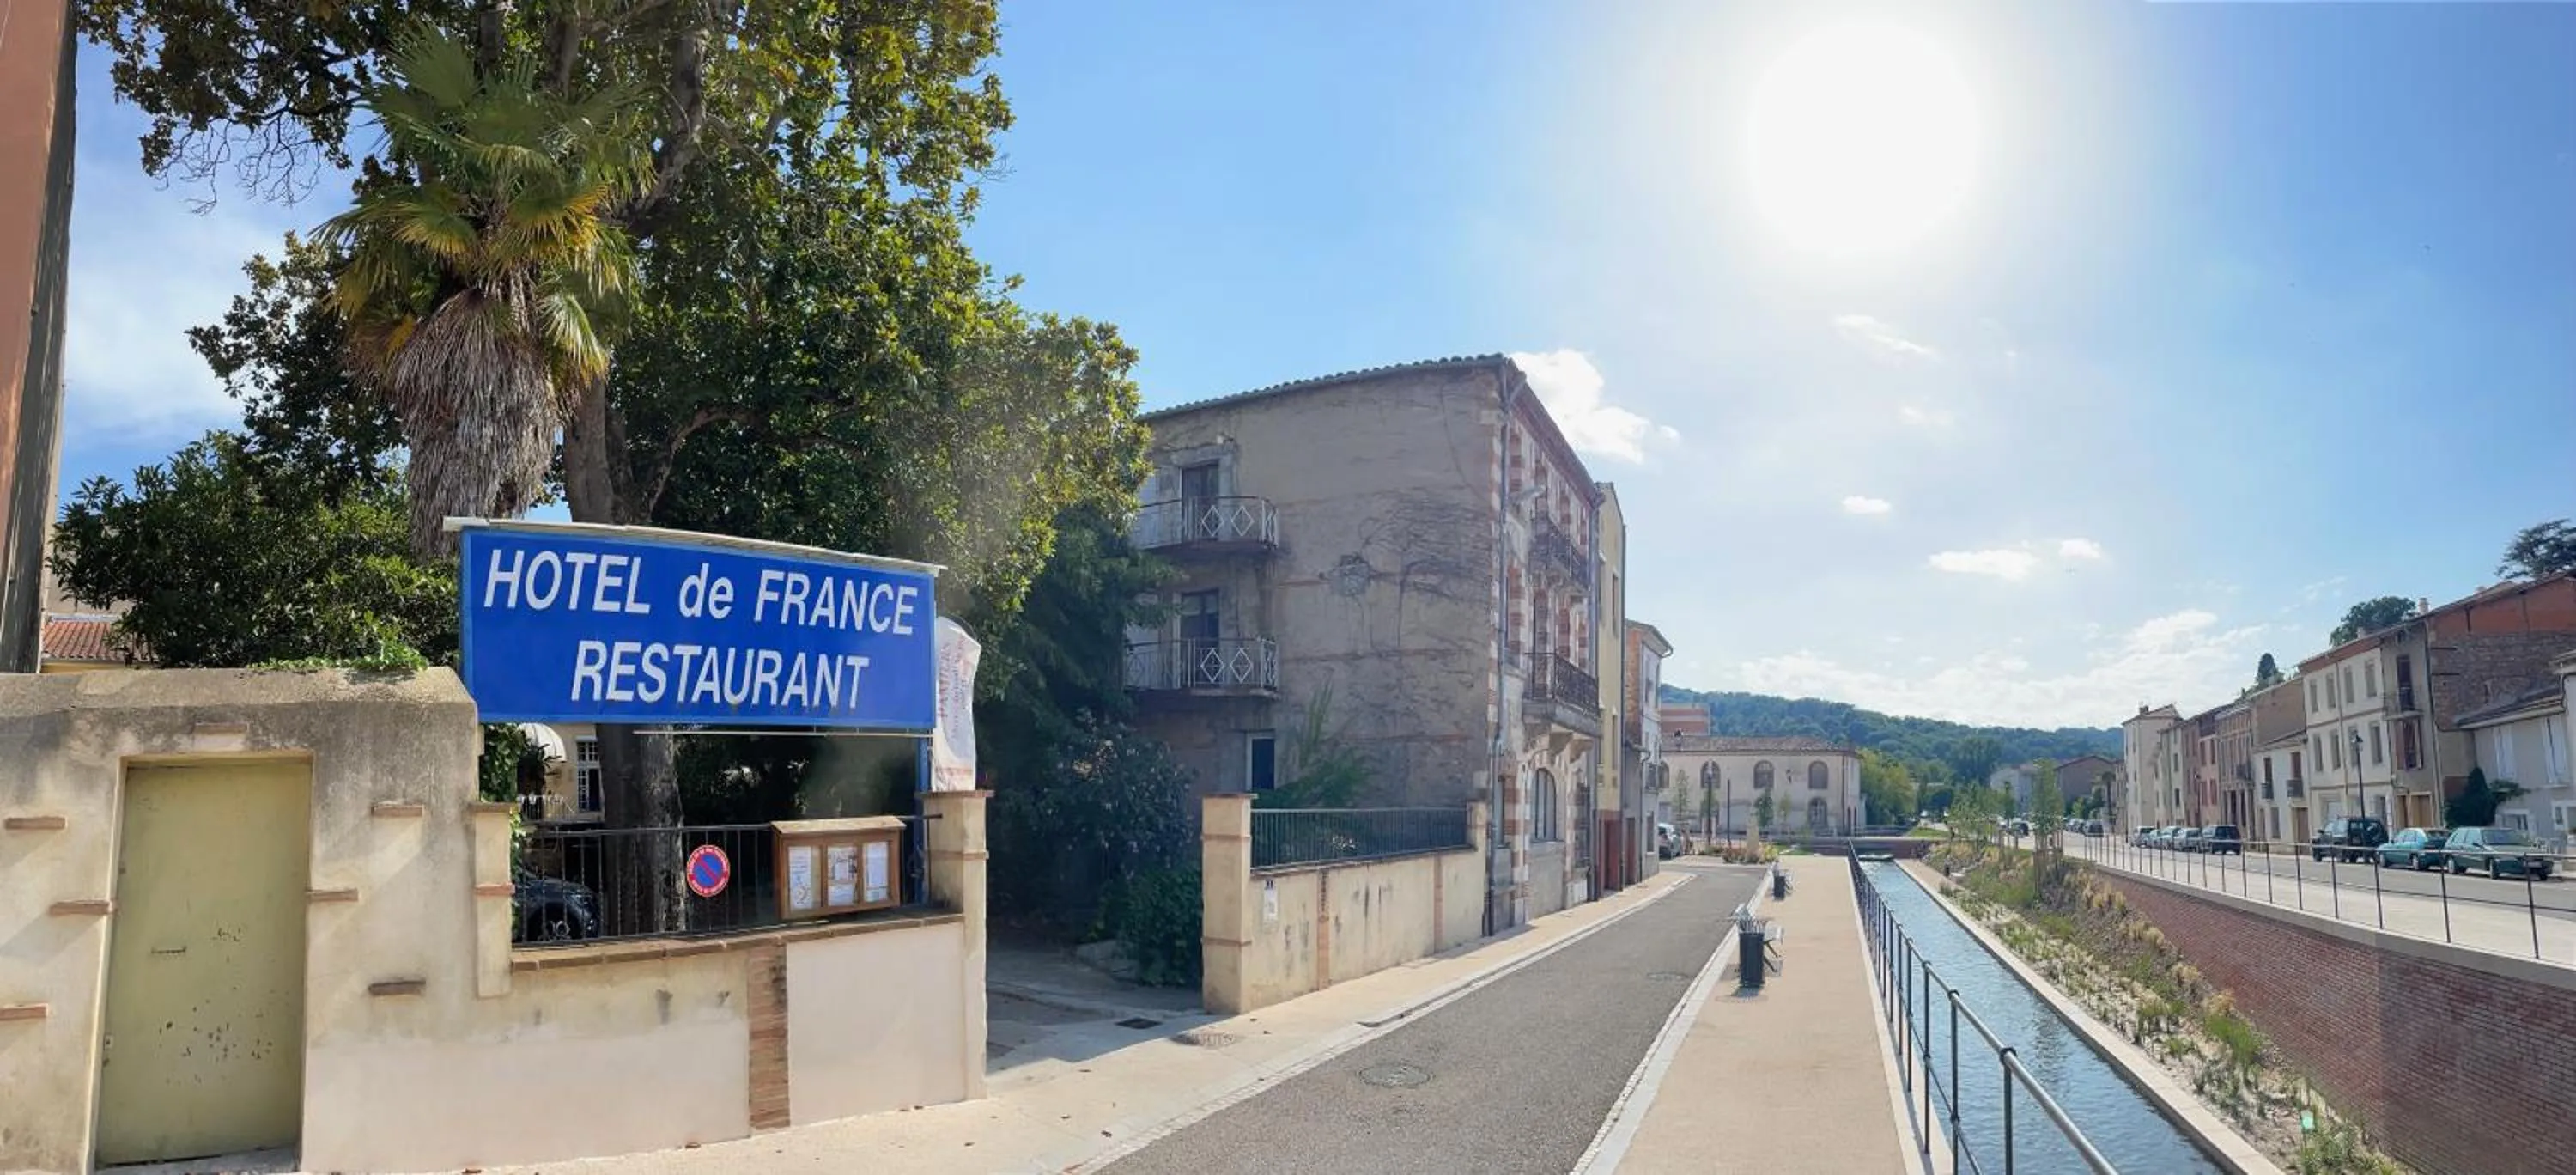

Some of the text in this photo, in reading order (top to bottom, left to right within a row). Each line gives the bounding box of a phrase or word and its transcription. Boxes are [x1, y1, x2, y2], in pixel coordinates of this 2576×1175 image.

[484, 549, 919, 636] HOTEL de FRANCE
[571, 640, 870, 710] RESTAURANT
